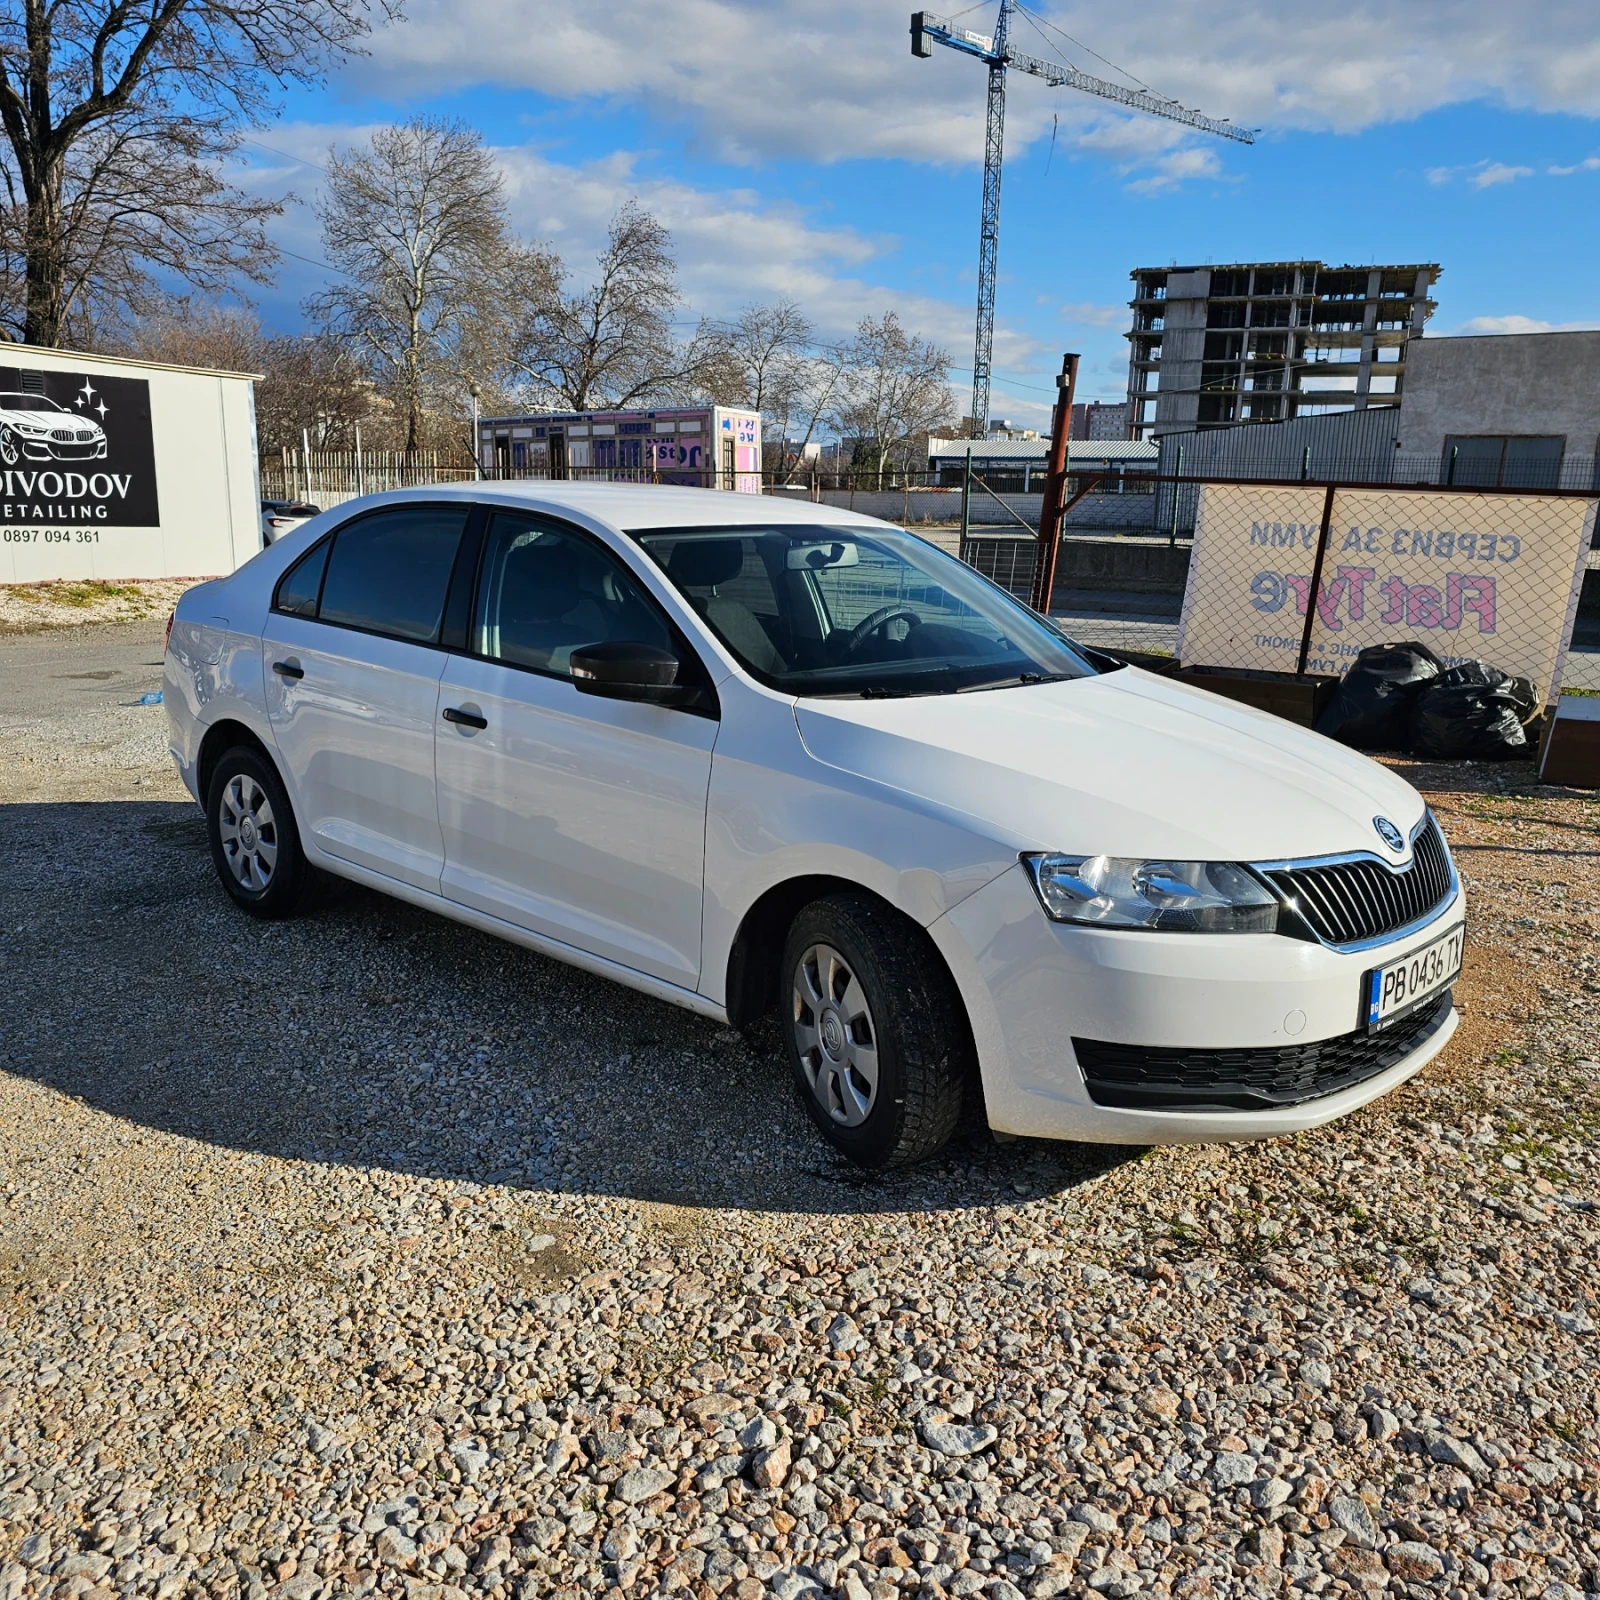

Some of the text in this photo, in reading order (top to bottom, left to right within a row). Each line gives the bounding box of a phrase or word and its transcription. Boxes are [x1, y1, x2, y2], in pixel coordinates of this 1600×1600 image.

[0, 470, 133, 499] IVODOV
[3, 529, 99, 543] 0897 094 361
[1382, 965, 1407, 1011] PB
[1409, 944, 1444, 996] 0436
